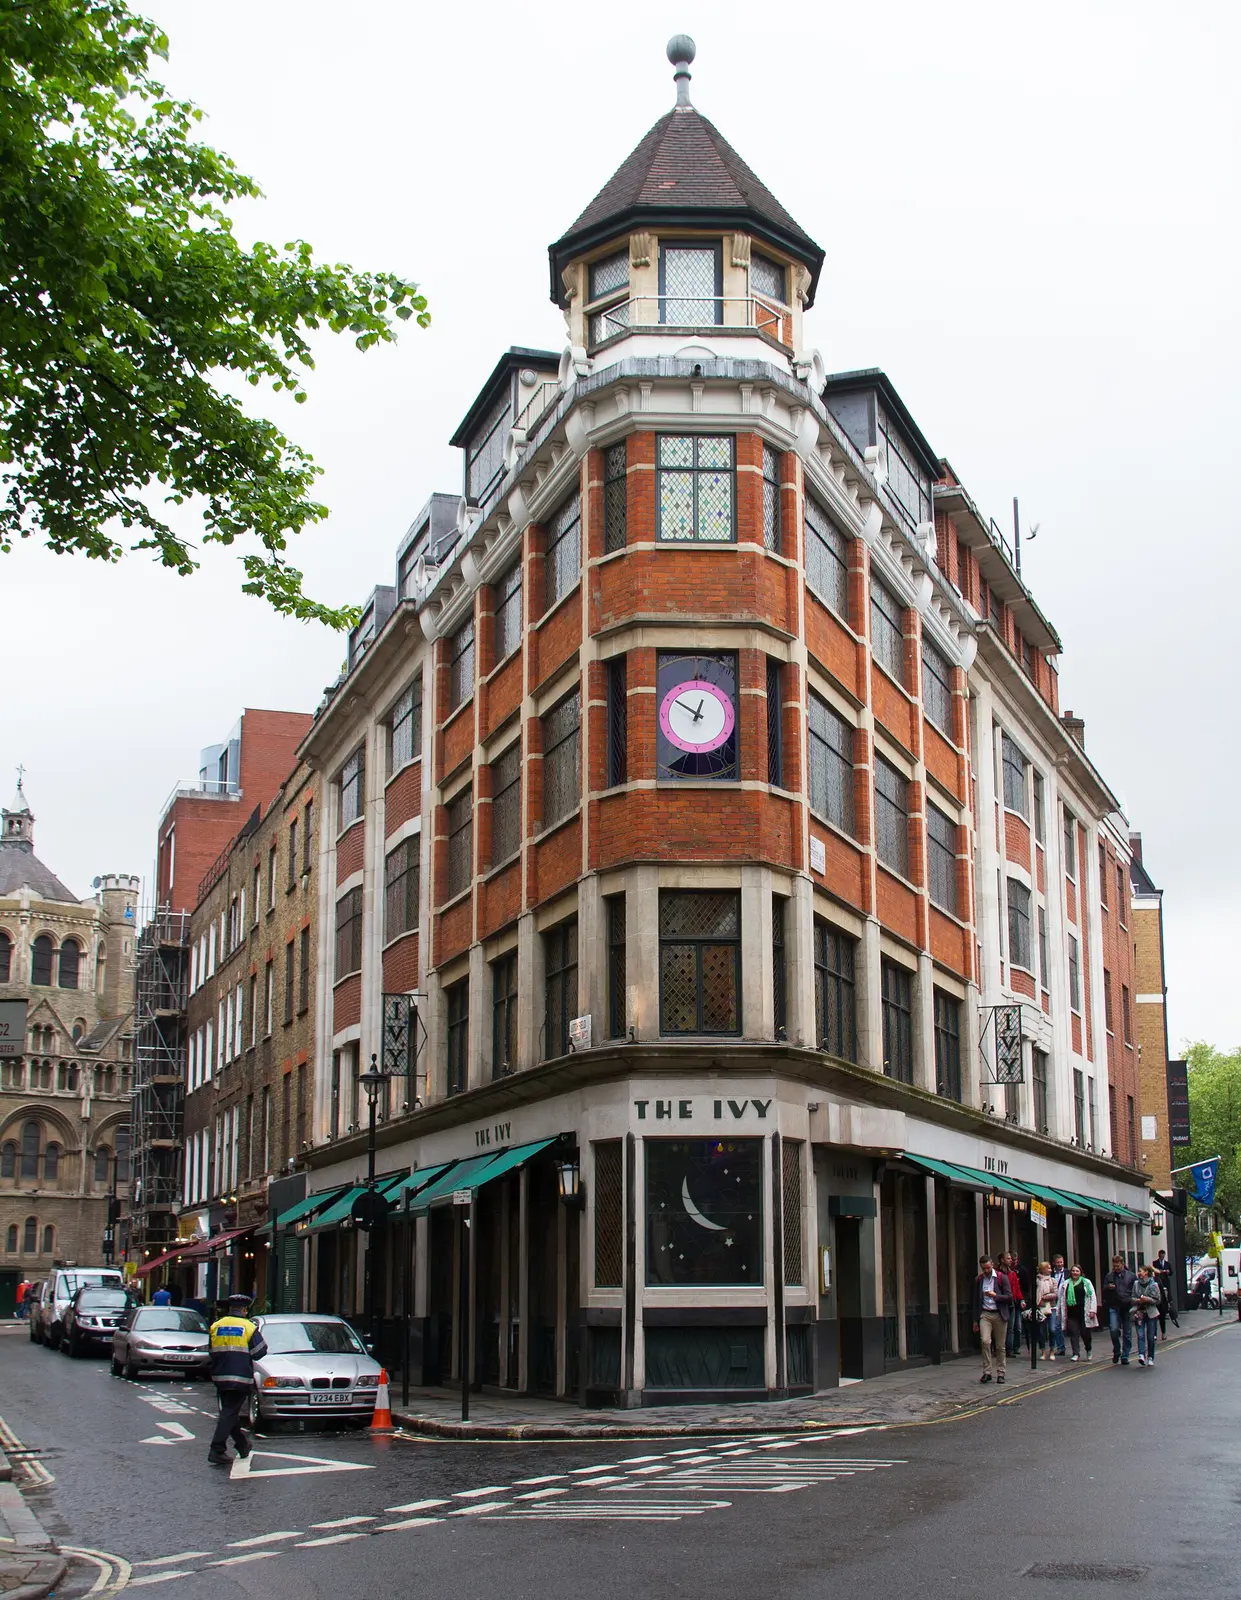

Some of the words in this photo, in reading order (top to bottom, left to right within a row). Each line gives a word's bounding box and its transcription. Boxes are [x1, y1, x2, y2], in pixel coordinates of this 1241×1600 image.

[386, 1002, 406, 1067] IVY
[1000, 1013, 1019, 1075] IVY
[634, 1100, 692, 1119] THE
[714, 1100, 772, 1119] IVY
[475, 1128, 490, 1147] THE
[494, 1121, 511, 1141] IVY
[984, 1156, 995, 1171] THE
[998, 1159, 1008, 1174] IVY
[313, 1394, 333, 1402] V234
[334, 1394, 349, 1402] EBX
